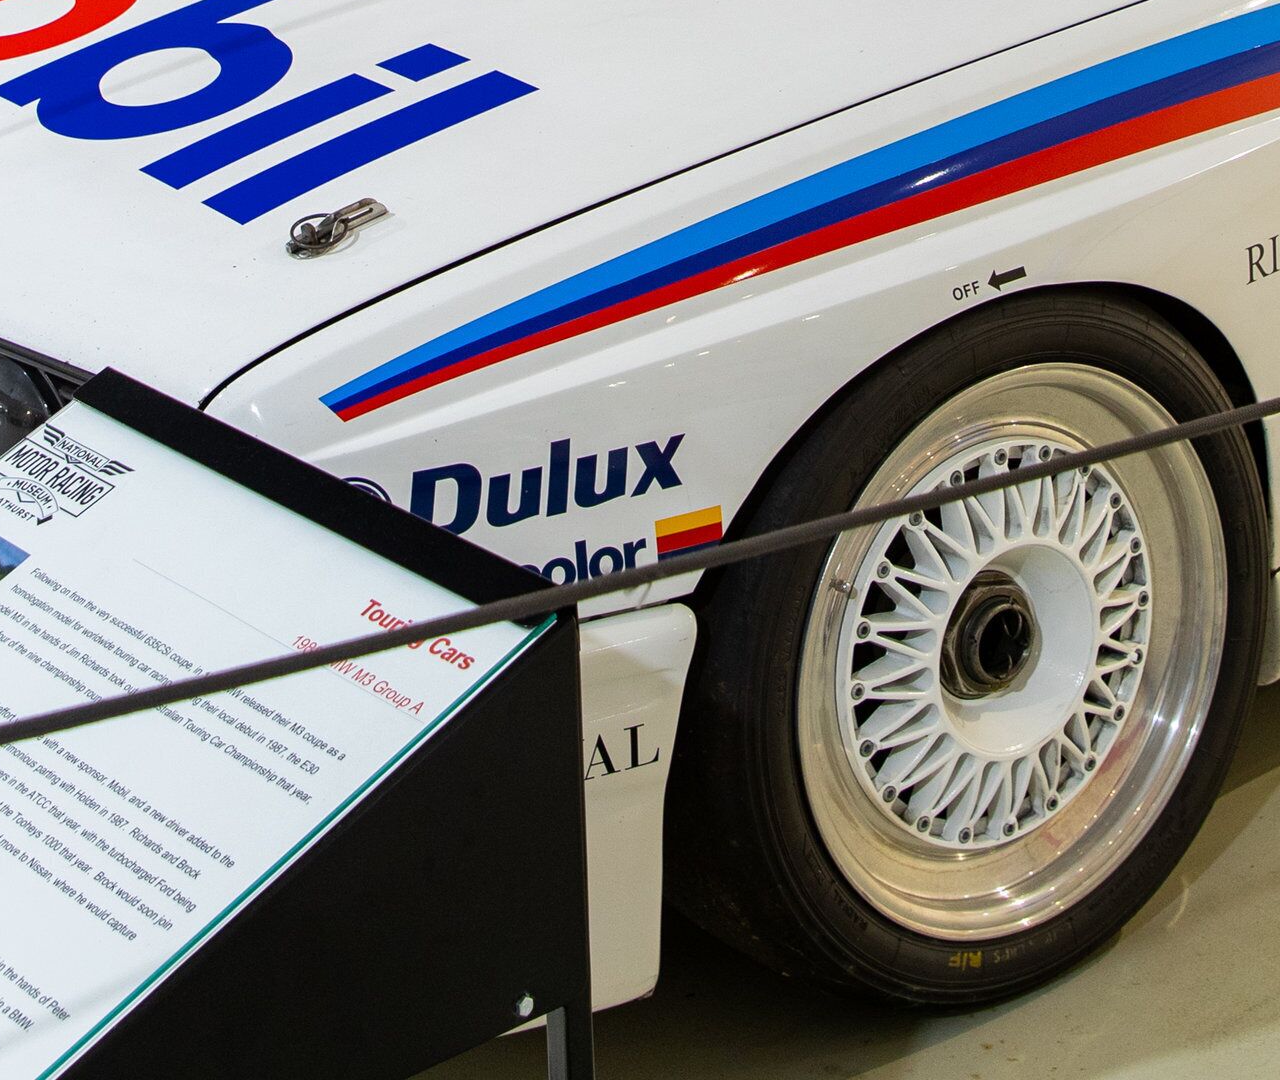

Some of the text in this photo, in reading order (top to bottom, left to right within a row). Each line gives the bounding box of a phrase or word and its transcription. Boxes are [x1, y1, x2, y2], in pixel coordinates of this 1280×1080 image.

[951, 280, 981, 302] OFF
[56, 439, 106, 468] NATIONAL
[3, 443, 107, 507] MOTOR RACING
[409, 432, 687, 537] Dulux
[9, 476, 56, 506] MUSEUM
[7, 582, 58, 616] homologation
[9, 610, 27, 623] M3
[19, 617, 34, 628] in
[50, 607, 77, 626] model
[70, 619, 87, 632] for
[26, 621, 45, 634] the
[351, 598, 482, 671] Touri Cars
[6, 637, 21, 649] of
[37, 628, 64, 647] hands
[57, 640, 72, 651] of
[79, 625, 118, 651] worldwide
[13, 642, 32, 655] the
[24, 648, 46, 664] nine
[64, 644, 84, 659] Jim
[109, 644, 142, 667] touring
[26, 567, 65, 592] Following
[57, 586, 72, 596] on
[67, 590, 89, 605] from
[82, 599, 101, 612] the
[92, 608, 112, 622] very
[107, 614, 149, 641] successful
[141, 634, 175, 656] 635CSi
[165, 651, 196, 672] coupe,
[191, 664, 206, 675] in
[223, 683, 245, 699] MW
[238, 692, 277, 718] released
[269, 710, 294, 728] their
[287, 721, 308, 736] M3
[298, 731, 330, 752] coupe
[324, 745, 341, 757] as
[76, 652, 113, 677] Richards
[135, 661, 152, 673] car
[36, 657, 90, 694] championship
[106, 671, 129, 687] took
[82, 687, 105, 704] roun
[122, 680, 142, 695] out
[350, 667, 377, 687] M3
[367, 679, 415, 711] Group
[150, 698, 187, 724] stralian
[198, 698, 222, 715] their
[215, 708, 240, 726] local
[177, 716, 215, 742] Touring
[233, 718, 262, 739] debut
[254, 731, 270, 744] in
[207, 733, 229, 750] Car
[261, 737, 292, 759] 1987,
[219, 742, 282, 784] Championship
[284, 750, 305, 765] the
[298, 758, 322, 776] E30
[274, 775, 297, 792] that
[41, 734, 63, 751] with
[61, 749, 82, 765] new
[74, 759, 111, 786] sponsor,
[104, 777, 135, 801] Mobil,
[127, 791, 149, 808] and
[148, 807, 169, 823] new
[164, 816, 193, 837] driver
[185, 830, 217, 854] added
[209, 846, 226, 860] to
[218, 852, 239, 869] the
[287, 786, 315, 806] year,
[6, 1007, 37, 1033] BMW.
